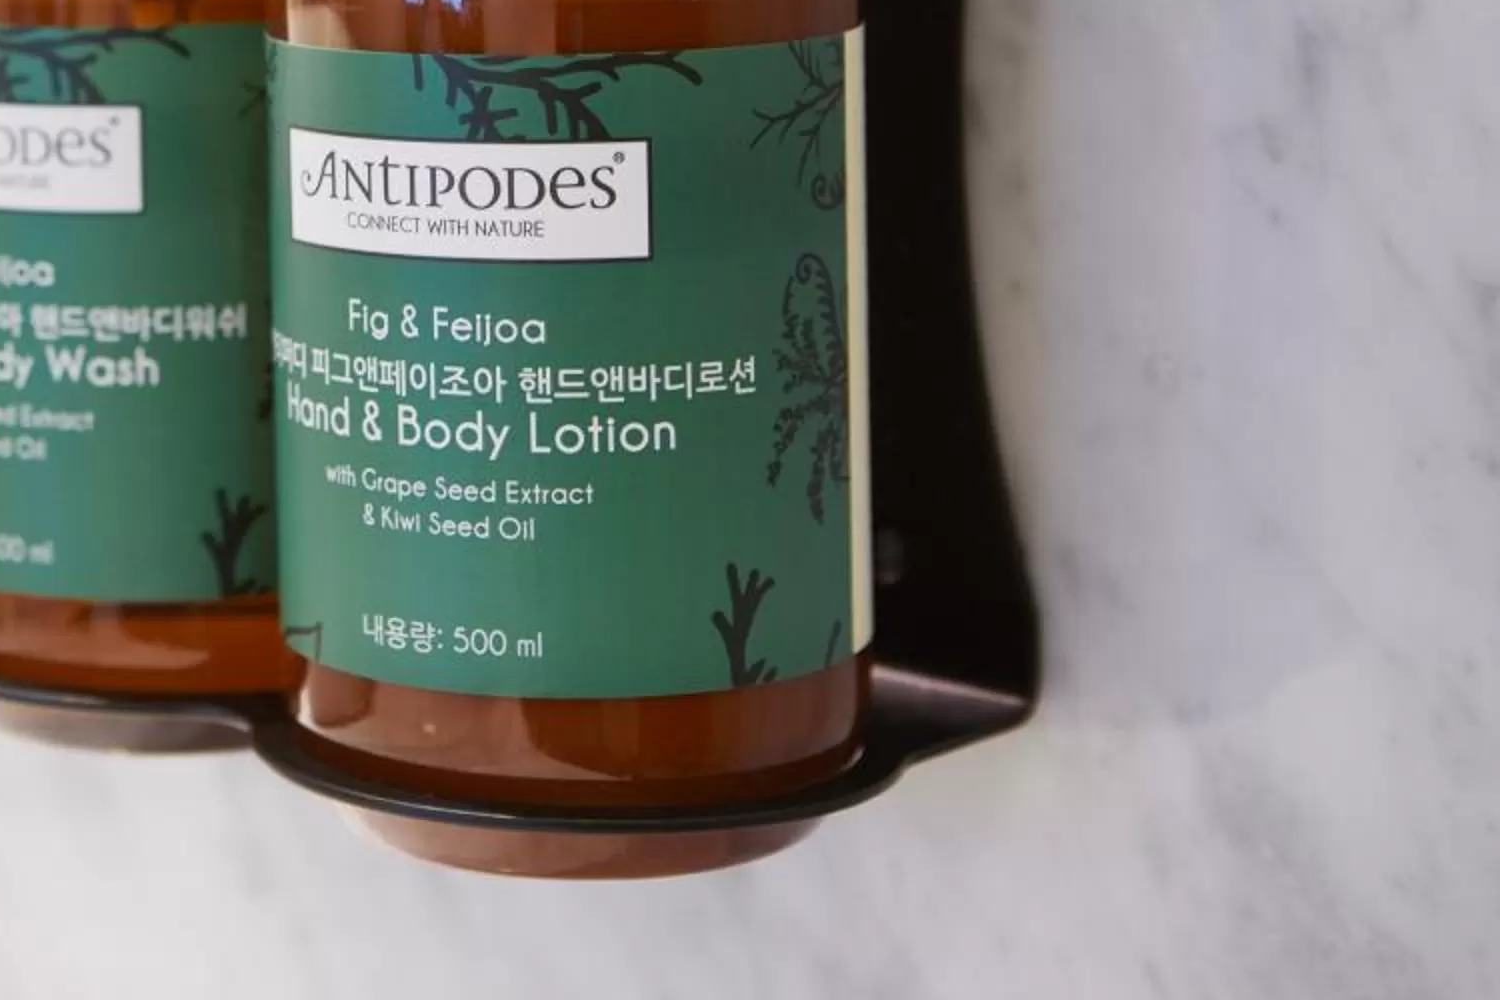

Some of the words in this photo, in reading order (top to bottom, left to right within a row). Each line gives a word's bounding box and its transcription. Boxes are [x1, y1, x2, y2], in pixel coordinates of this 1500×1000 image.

[347, 211, 421, 234] CONNECT
[428, 215, 470, 237] WITH
[475, 218, 546, 239] NATURE
[348, 298, 390, 341] Fig
[400, 303, 420, 339] &
[432, 305, 546, 348] Feijoa
[43, 343, 161, 389] Wash
[311, 346, 507, 404] 피그앤페이조아
[518, 355, 757, 404] 핸드앤바디로션
[287, 379, 350, 438] Hand
[361, 400, 383, 442] &
[396, 402, 511, 462] Body
[529, 411, 677, 455] Lotion
[325, 463, 357, 488] with
[361, 467, 427, 502] Grape
[434, 476, 498, 503] Seed
[505, 480, 595, 506] Extract
[361, 502, 376, 526] &
[381, 505, 422, 533] Kiwi
[428, 511, 491, 540] Seed
[498, 516, 536, 542] Oil
[361, 612, 444, 655] 내용량:
[452, 626, 508, 658] 500
[516, 631, 543, 659] ml
